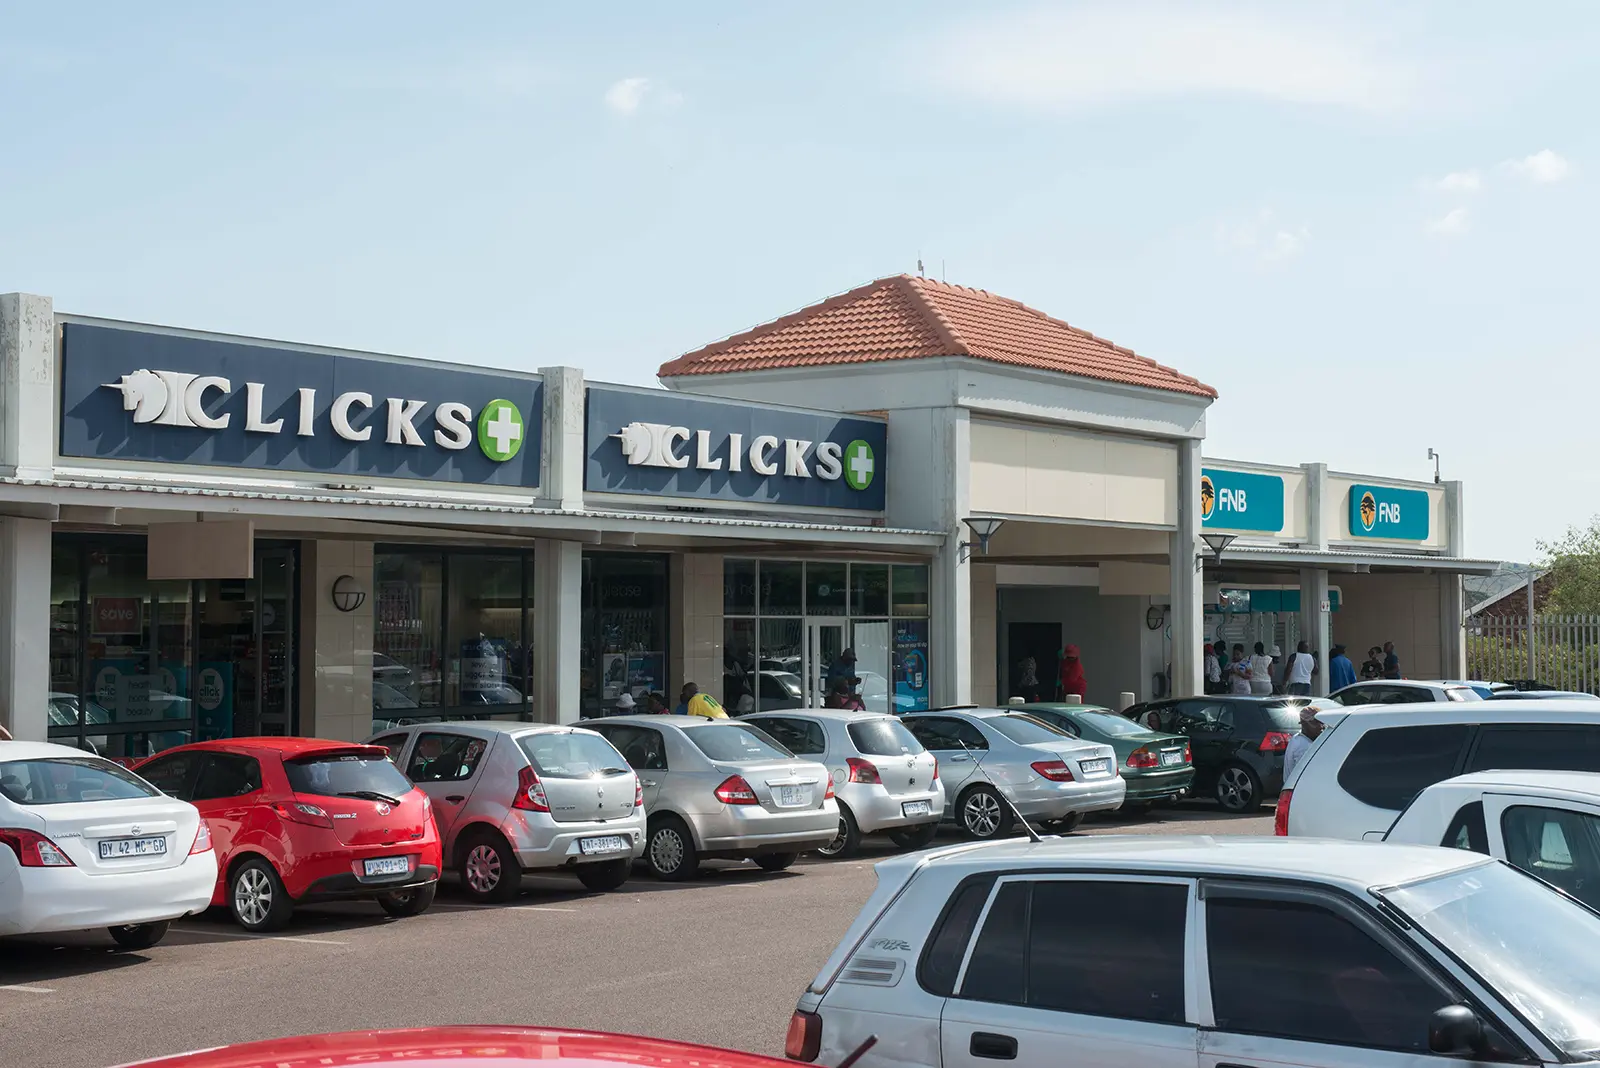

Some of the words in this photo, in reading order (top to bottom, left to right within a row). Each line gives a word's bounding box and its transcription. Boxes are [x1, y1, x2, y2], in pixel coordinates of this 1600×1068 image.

[184, 375, 473, 451] CLICKS
[662, 425, 843, 481] CLICKS
[1219, 488, 1247, 512] FNB
[1379, 502, 1401, 523] FNB
[100, 608, 134, 621] save
[199, 685, 220, 697] click
[102, 843, 113, 856] DY
[118, 842, 130, 854] 42
[135, 840, 146, 853] MC
[153, 839, 164, 852] GP
